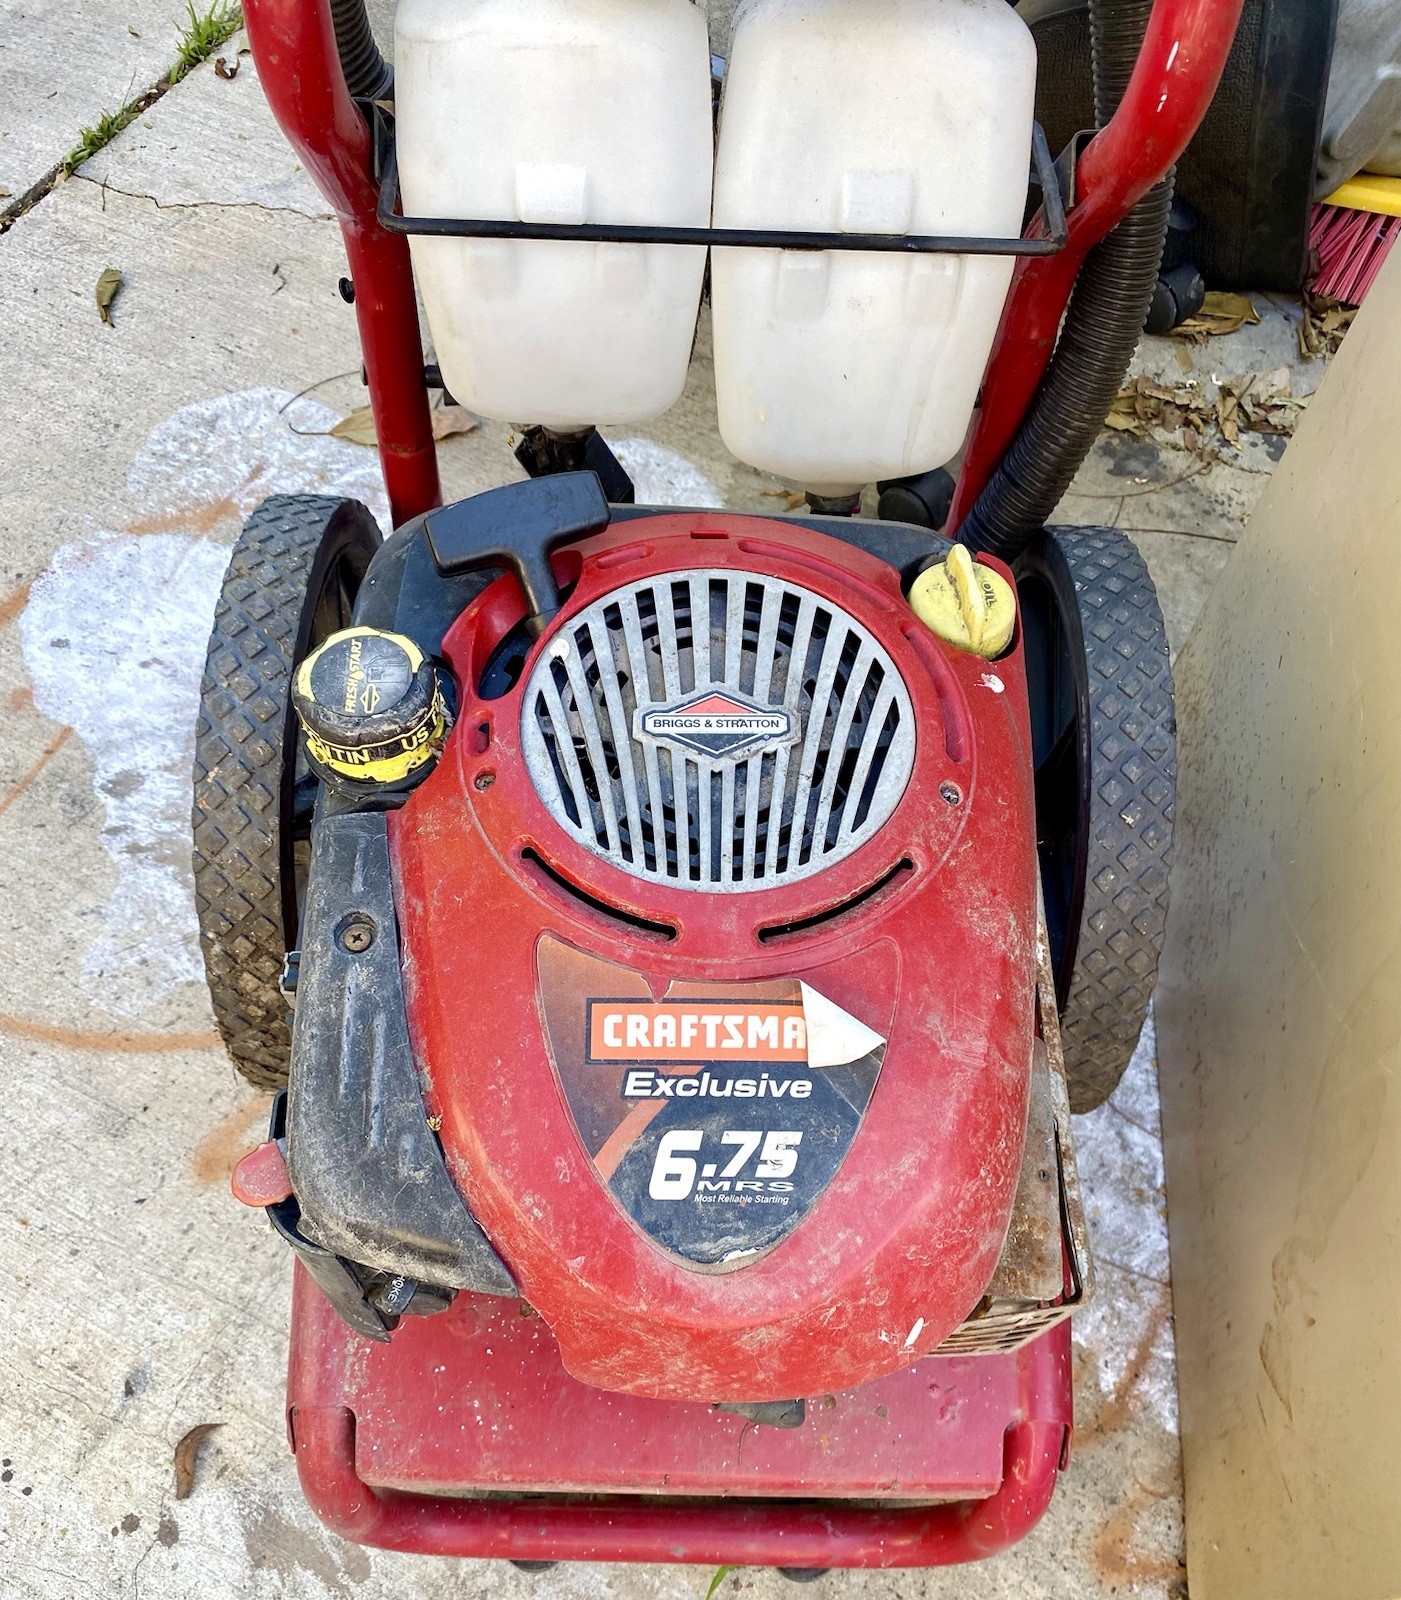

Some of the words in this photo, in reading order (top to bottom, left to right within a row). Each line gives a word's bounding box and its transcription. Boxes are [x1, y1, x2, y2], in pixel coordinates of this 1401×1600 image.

[981, 581, 997, 608] OIL
[349, 639, 363, 673] START
[344, 677, 359, 714] FRESH
[653, 719, 701, 728] BRIGGS
[704, 719, 713, 728] &
[715, 719, 780, 728] STRATTON
[603, 1014, 808, 1050] CRAFTSMA
[624, 1071, 812, 1099] Exclusive
[648, 1129, 804, 1201] 6.75
[694, 1193, 717, 1203] Most
[717, 1193, 753, 1204] Reliable
[754, 1193, 790, 1206] Starting
[696, 1180, 795, 1193] MRS
[387, 1273, 406, 1303] HOKE
